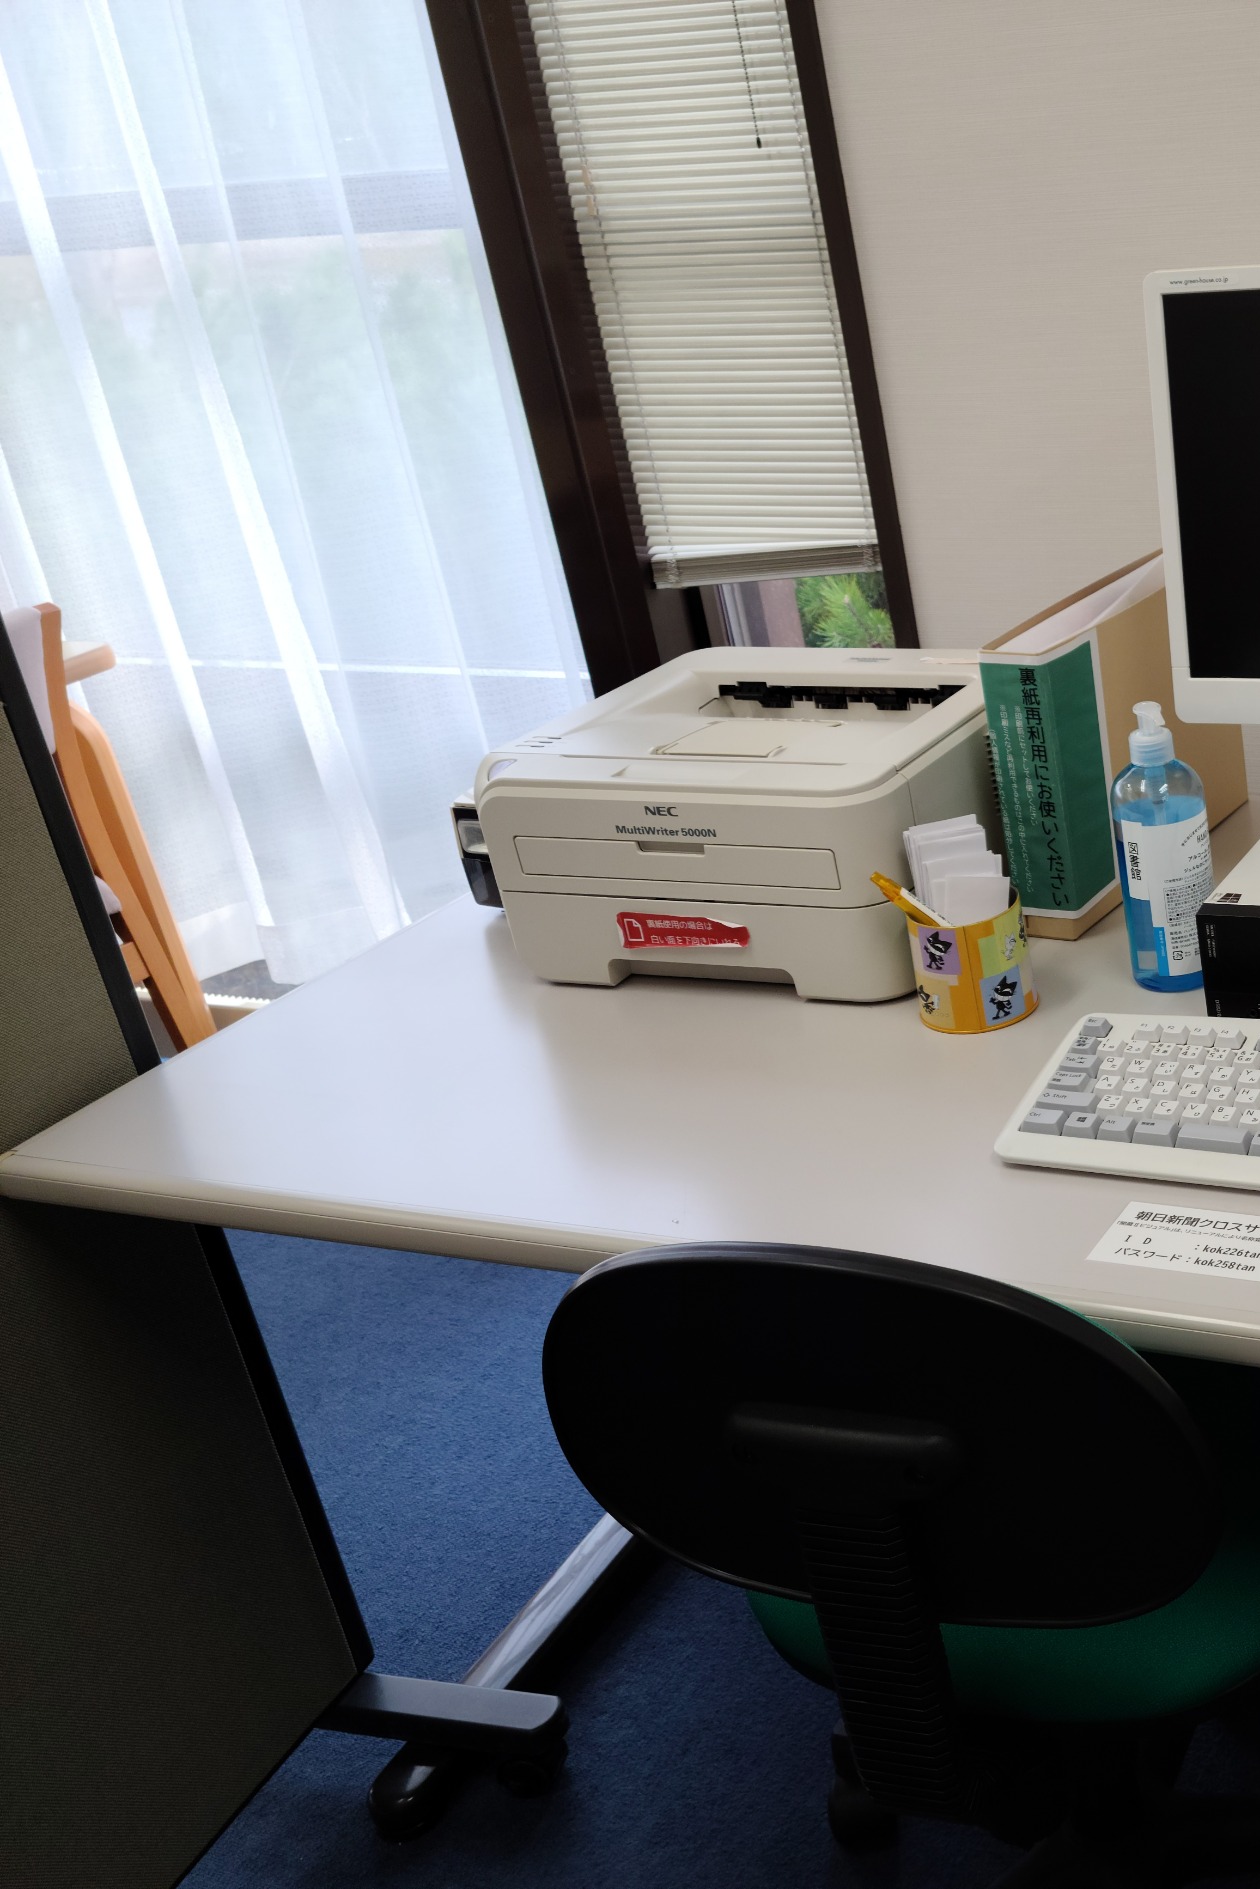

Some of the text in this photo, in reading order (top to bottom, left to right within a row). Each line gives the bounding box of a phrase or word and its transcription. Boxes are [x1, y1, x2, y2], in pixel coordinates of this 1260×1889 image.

[1018, 666, 1070, 907] 裏紙再利用にお使いください
[644, 805, 679, 817] NEC
[615, 824, 717, 839] MultiWriter 5000N
[645, 919, 713, 931] 裏紙使用の場合は
